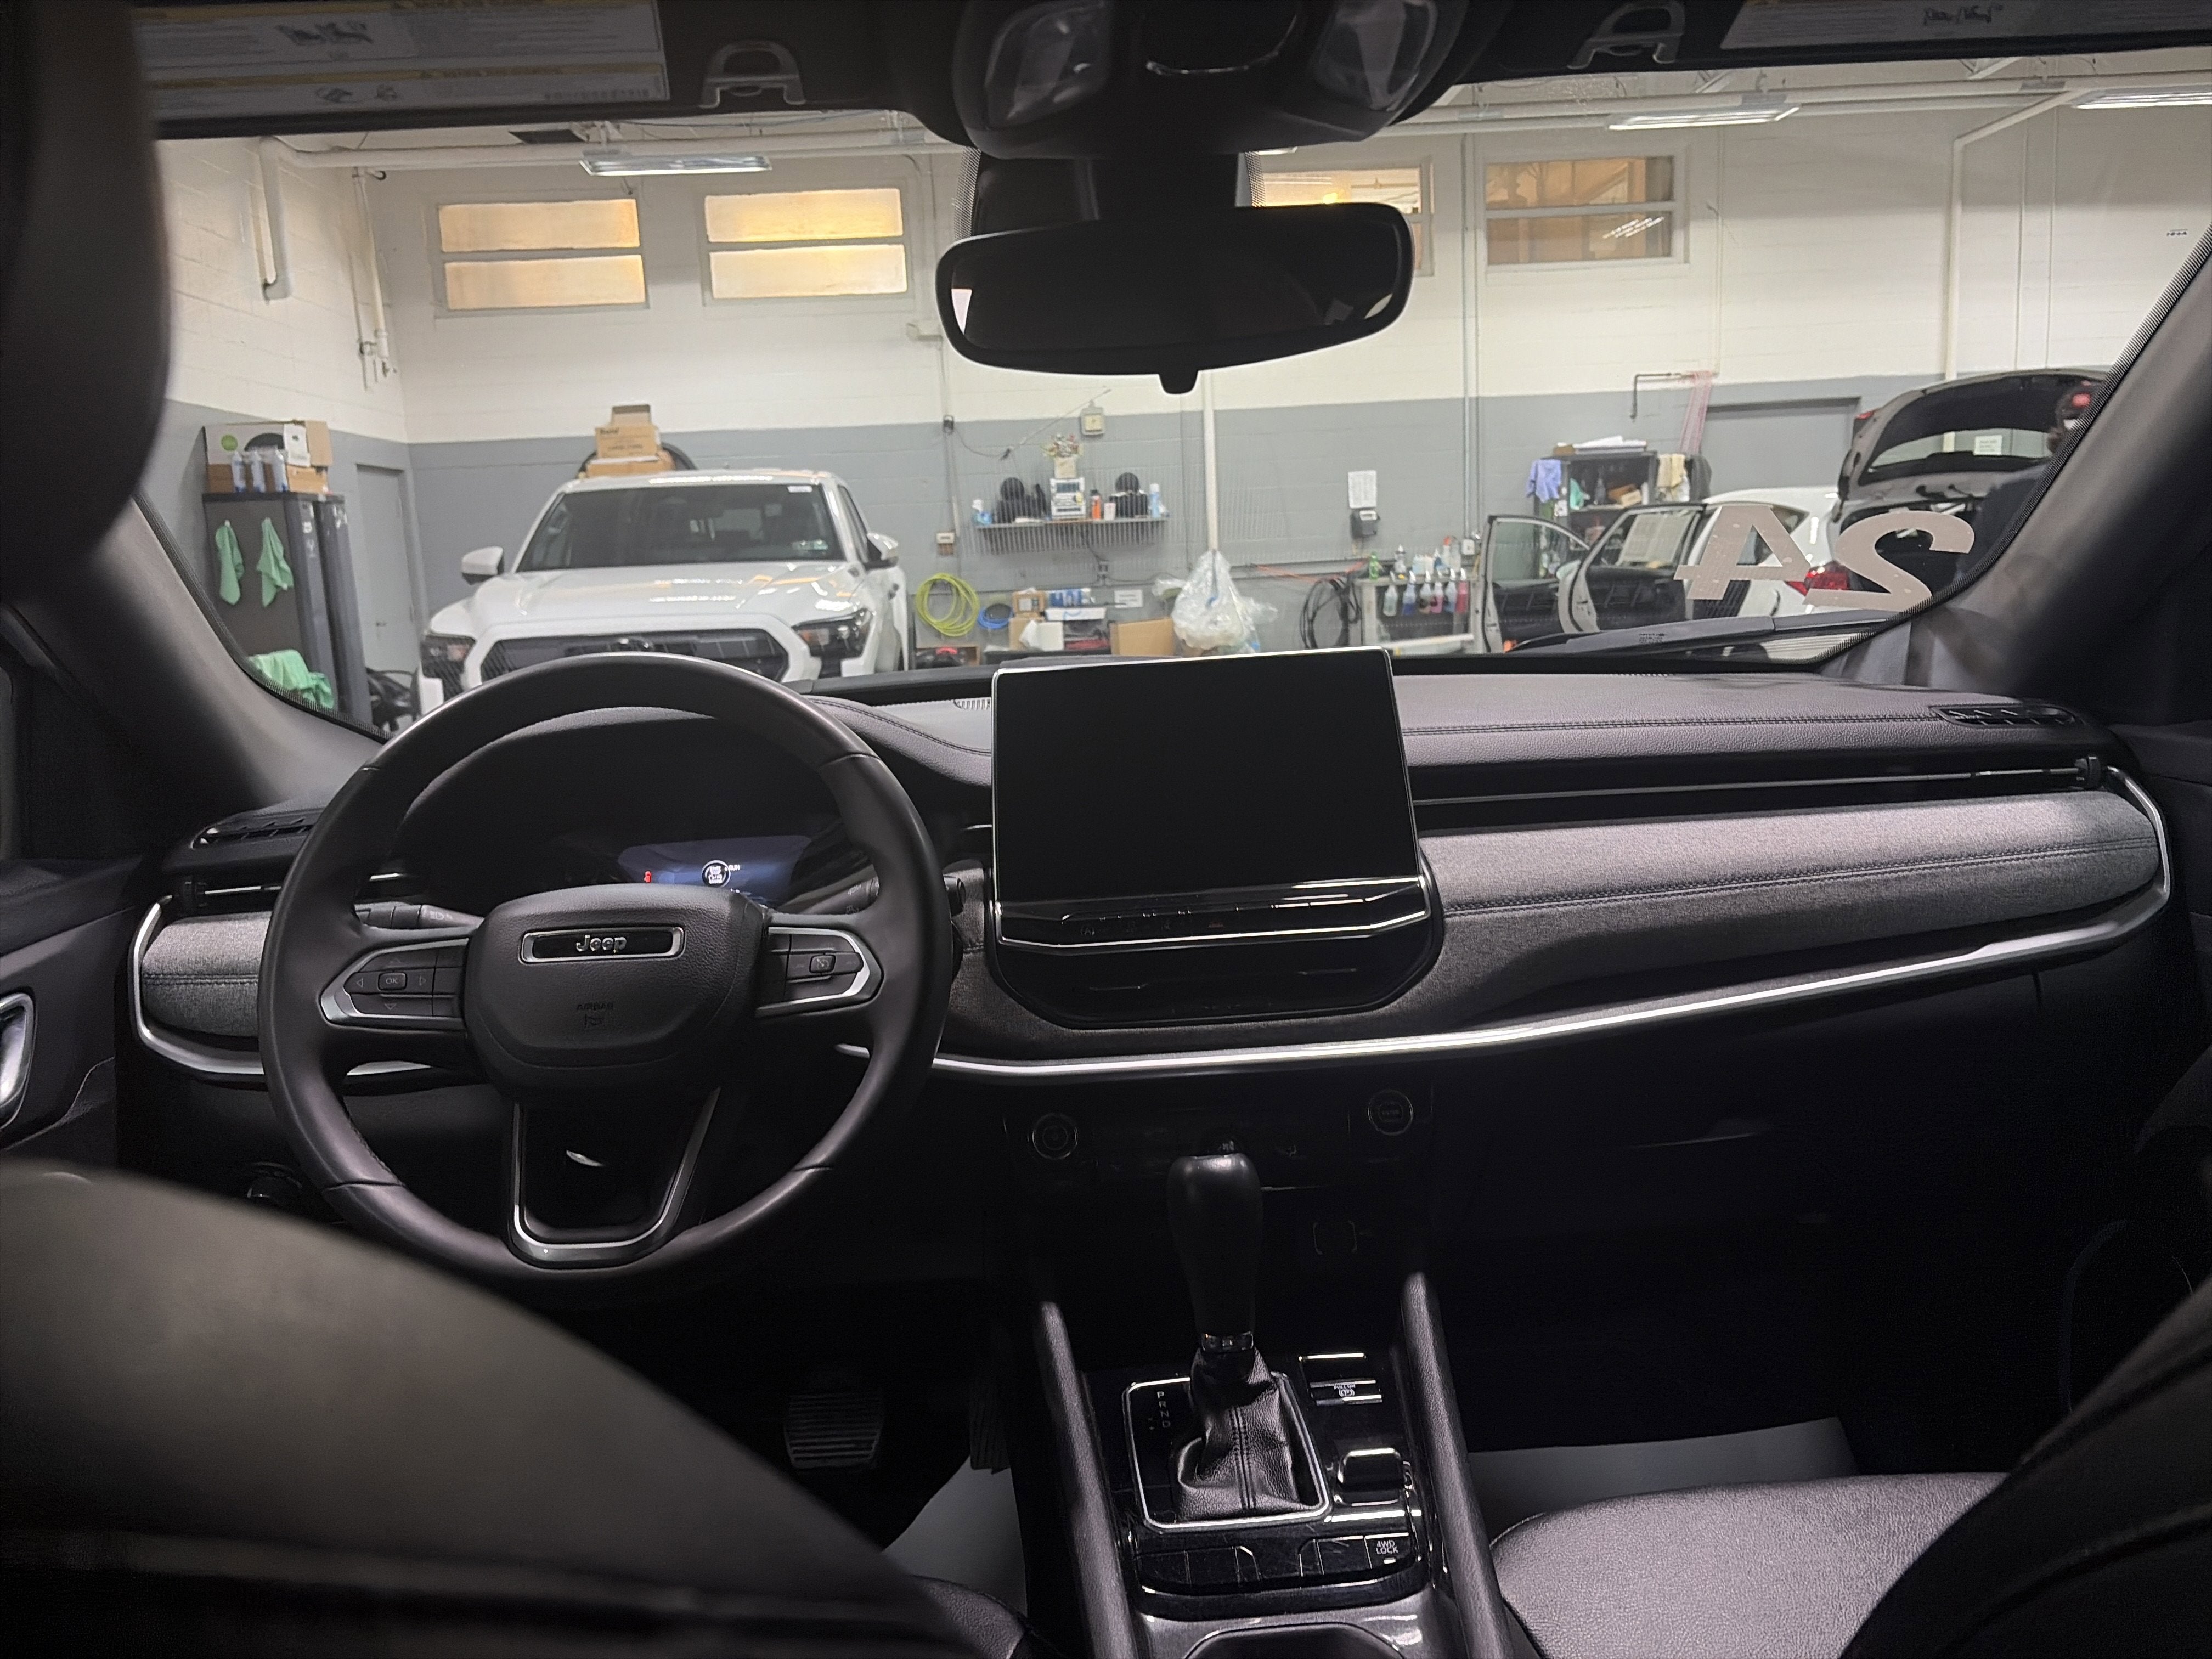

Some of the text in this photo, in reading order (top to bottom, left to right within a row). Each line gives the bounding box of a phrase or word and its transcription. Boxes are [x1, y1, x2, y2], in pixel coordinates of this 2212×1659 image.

[576, 934, 627, 953] Jeep
[1376, 1539, 1395, 1548] 4WD
[1376, 1546, 1398, 1555] LOCK
